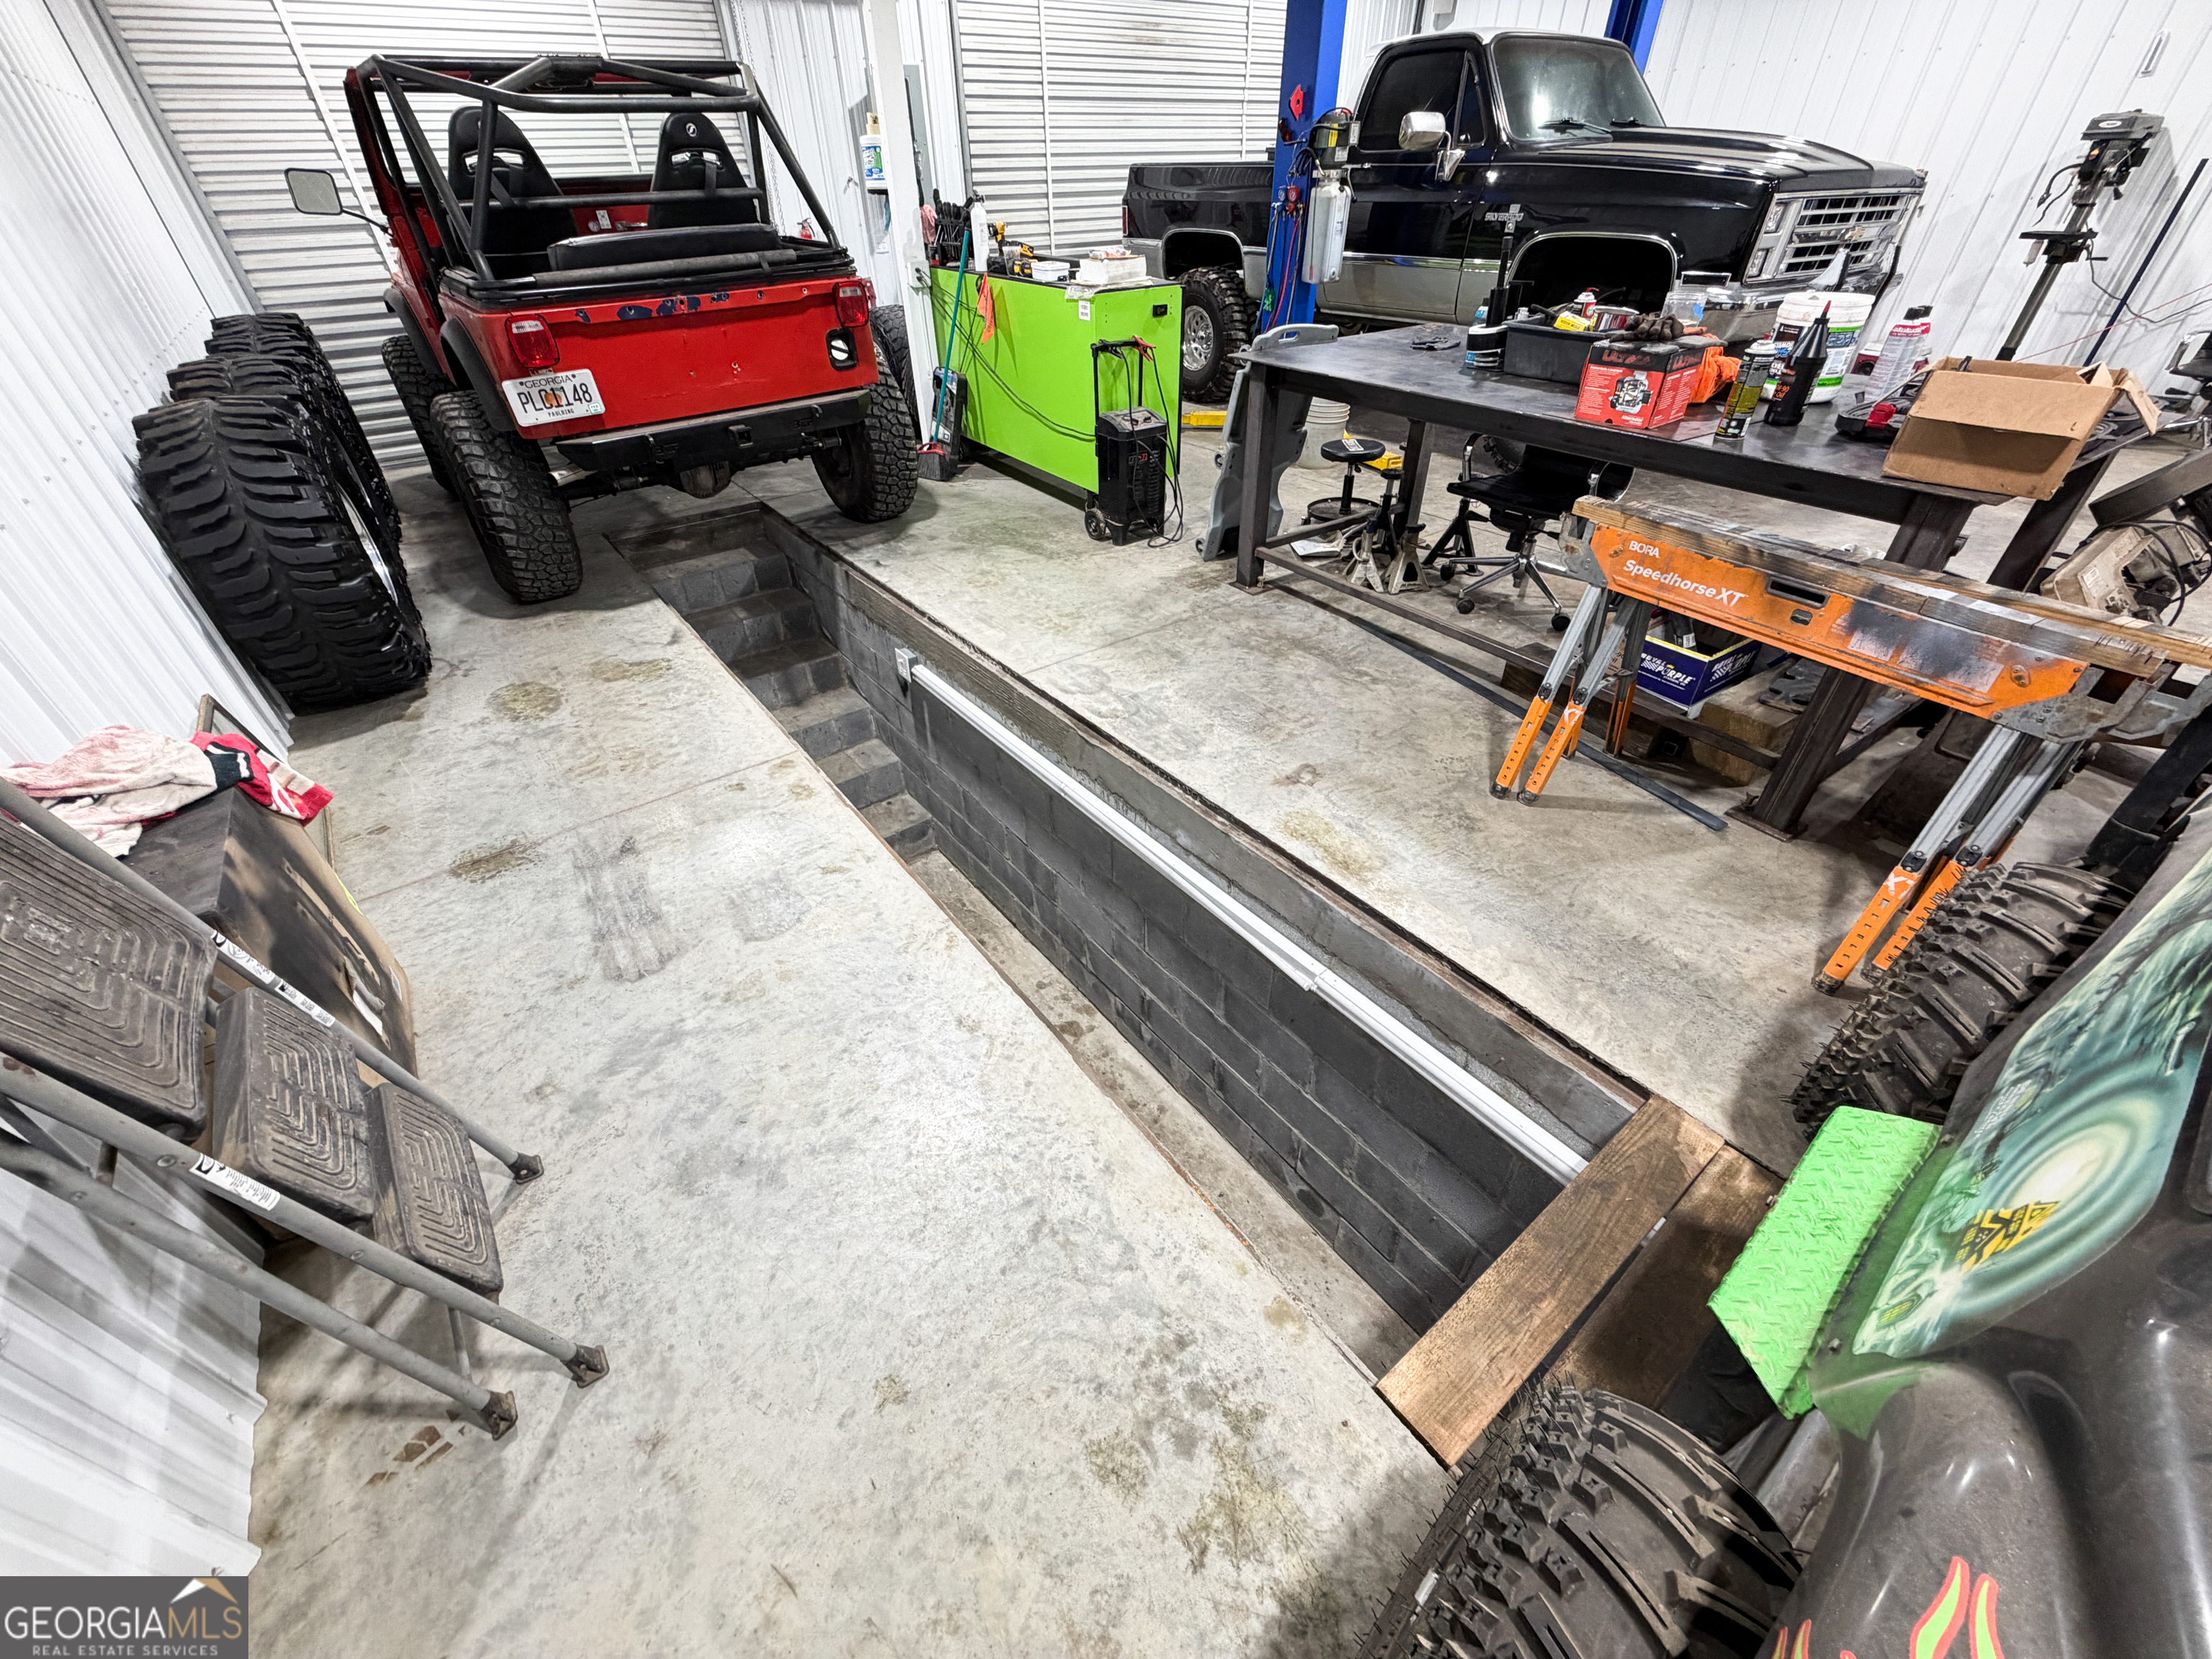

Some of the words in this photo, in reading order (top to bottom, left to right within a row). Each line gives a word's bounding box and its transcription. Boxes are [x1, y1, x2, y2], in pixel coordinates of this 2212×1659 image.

[1484, 212, 1524, 222] SILVERADO
[524, 374, 573, 390] GEORGIA
[517, 382, 593, 414] PLC1148
[548, 408, 575, 418] PAULDING
[1629, 540, 1660, 558] BORA
[1640, 652, 1667, 667] ROYAL
[1655, 665, 1694, 685] PURPLE
